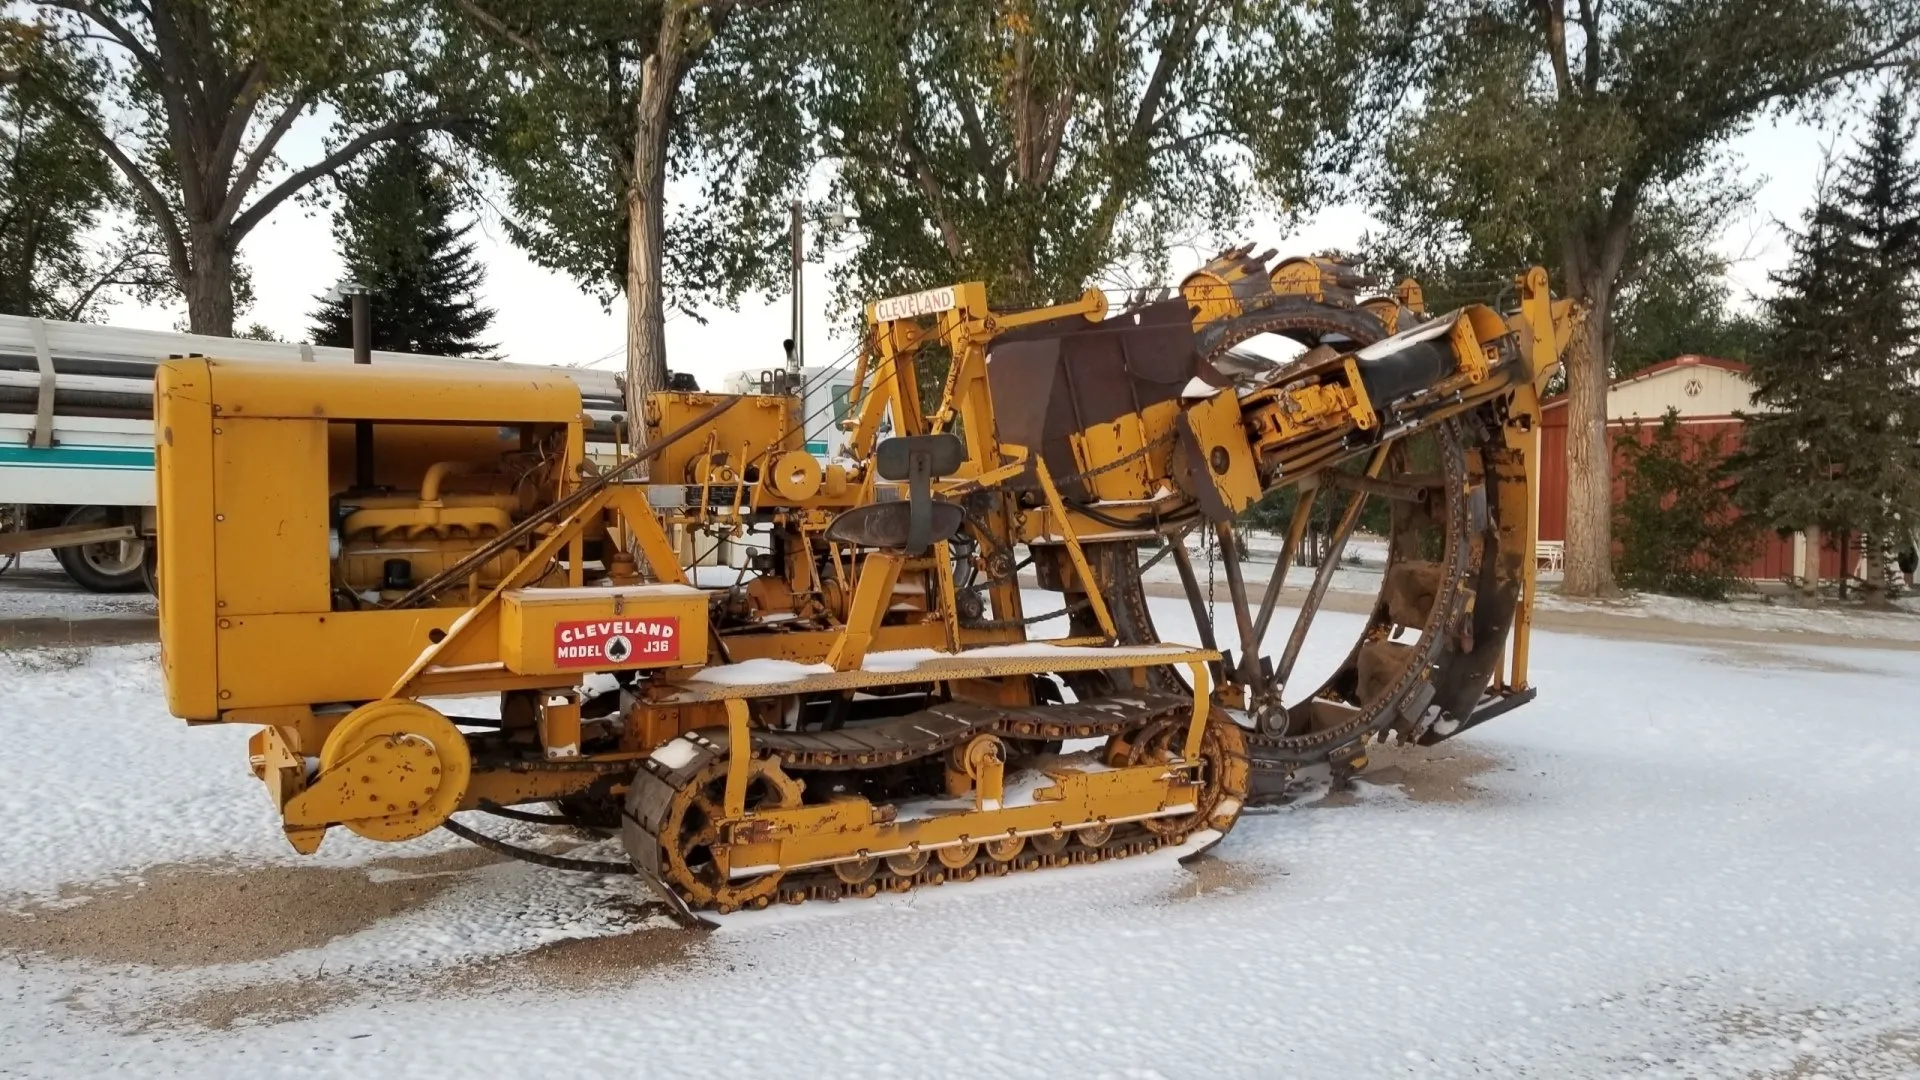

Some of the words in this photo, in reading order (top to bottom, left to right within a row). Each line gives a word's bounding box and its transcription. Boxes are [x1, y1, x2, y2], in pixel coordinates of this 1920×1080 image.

[878, 290, 951, 320] CLEVELAND
[560, 621, 674, 643] CLEVELAND
[557, 644, 603, 659] MODEL
[643, 640, 670, 653] J36
